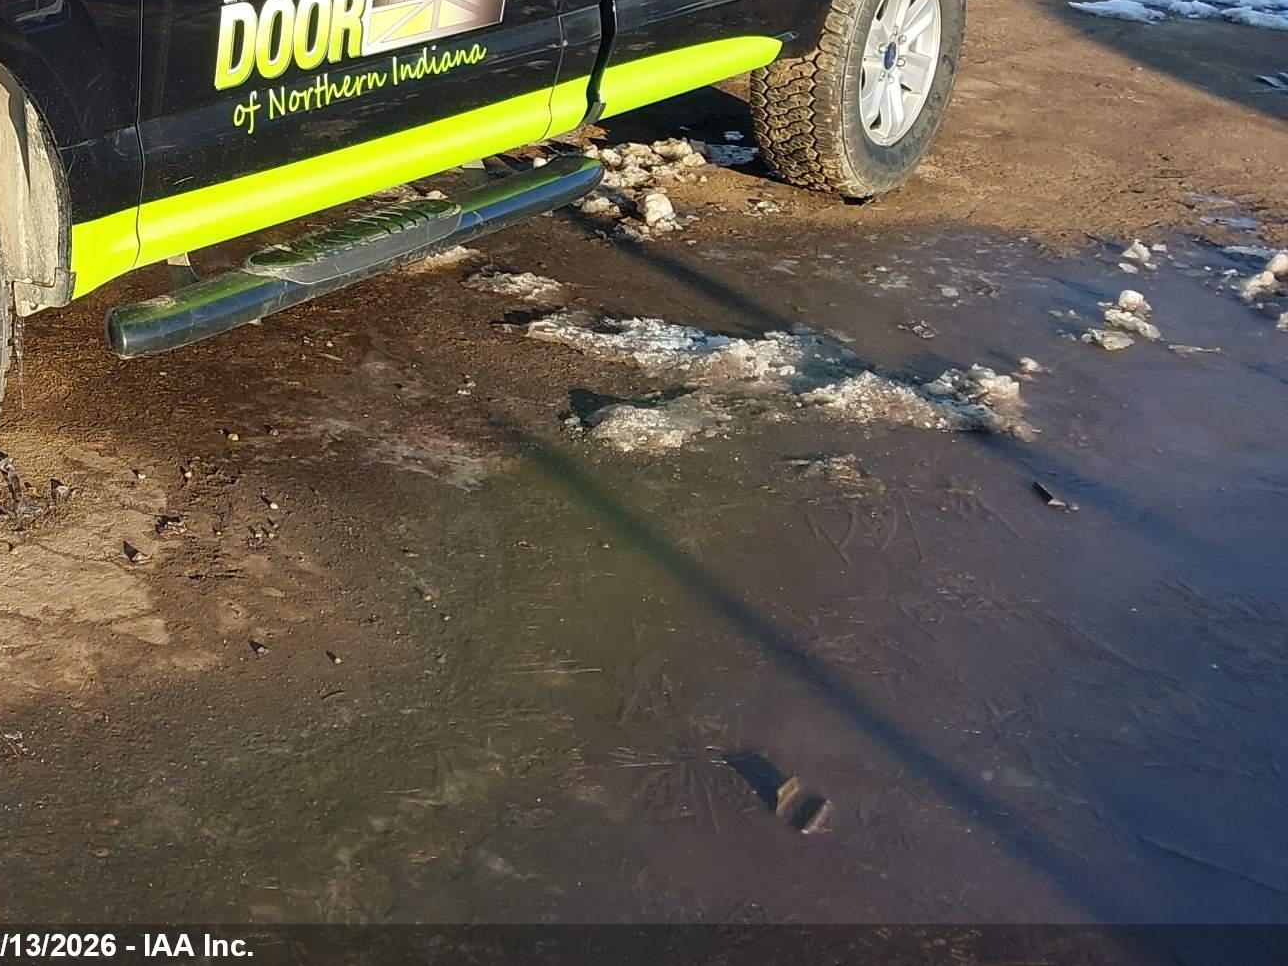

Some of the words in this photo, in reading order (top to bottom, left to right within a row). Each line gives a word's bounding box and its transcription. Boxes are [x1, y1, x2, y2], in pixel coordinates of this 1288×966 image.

[232, 90, 261, 135] of
[268, 69, 388, 120] Northern
[391, 42, 488, 85] Indiana
